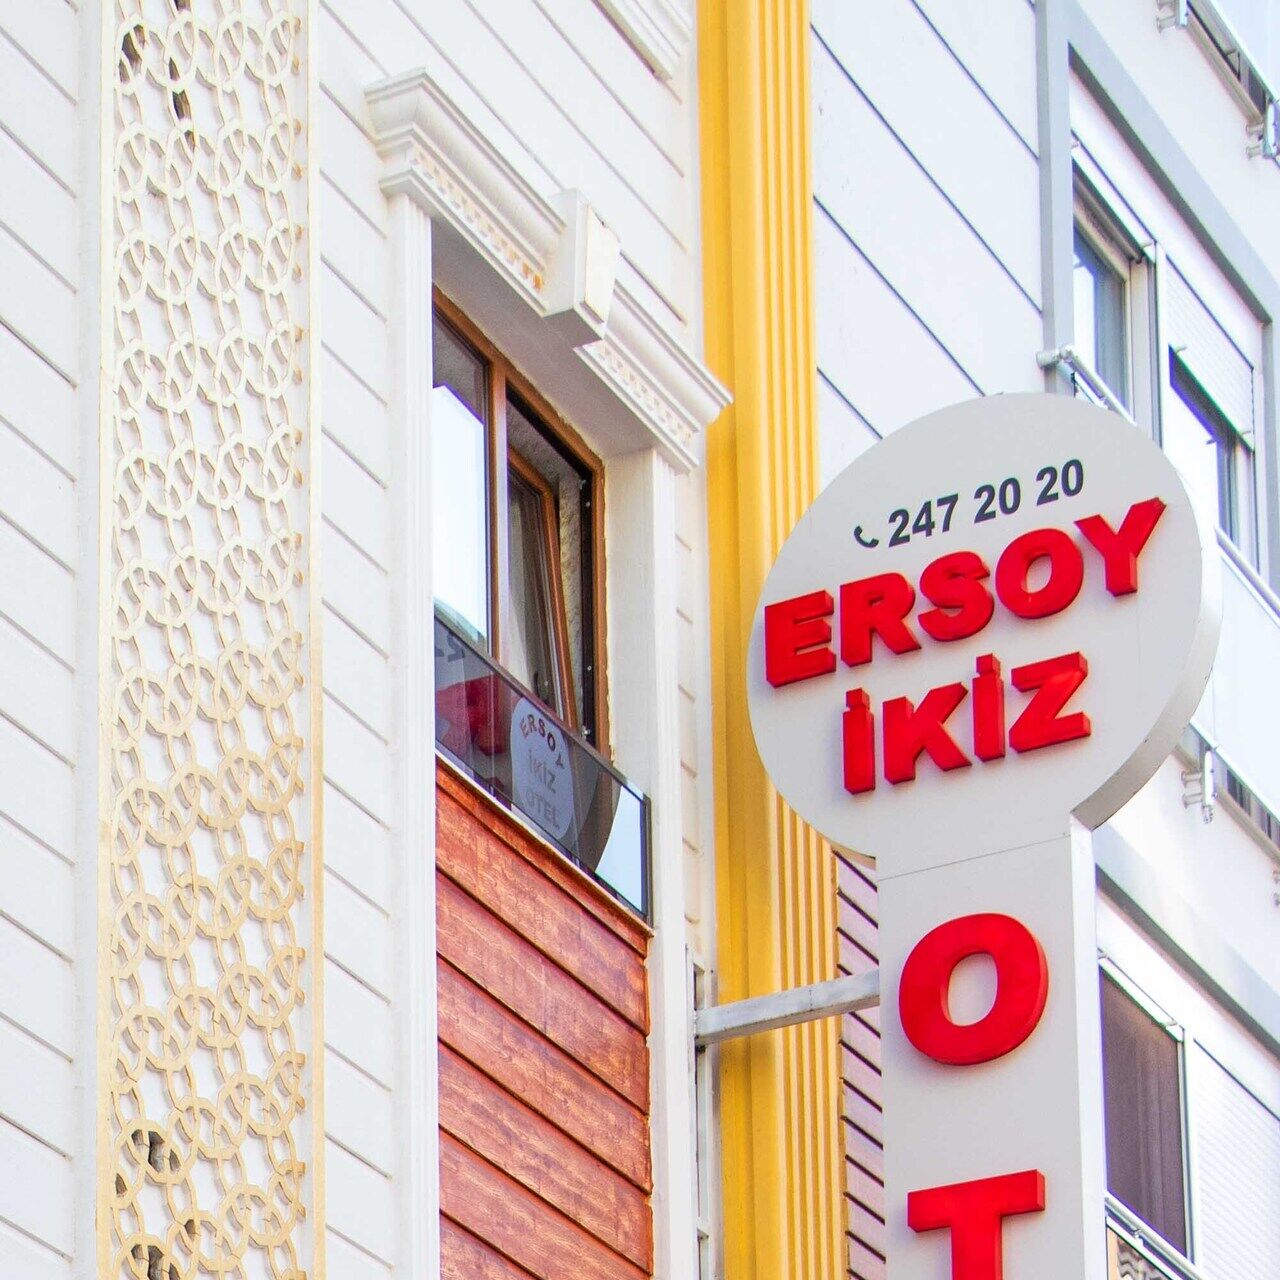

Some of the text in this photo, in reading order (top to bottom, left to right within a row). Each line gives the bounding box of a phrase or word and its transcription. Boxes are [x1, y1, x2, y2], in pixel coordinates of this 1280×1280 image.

[888, 459, 1084, 549] 247 20 20
[764, 497, 1167, 689] ERSOY
[841, 652, 1092, 796] İKİZ
